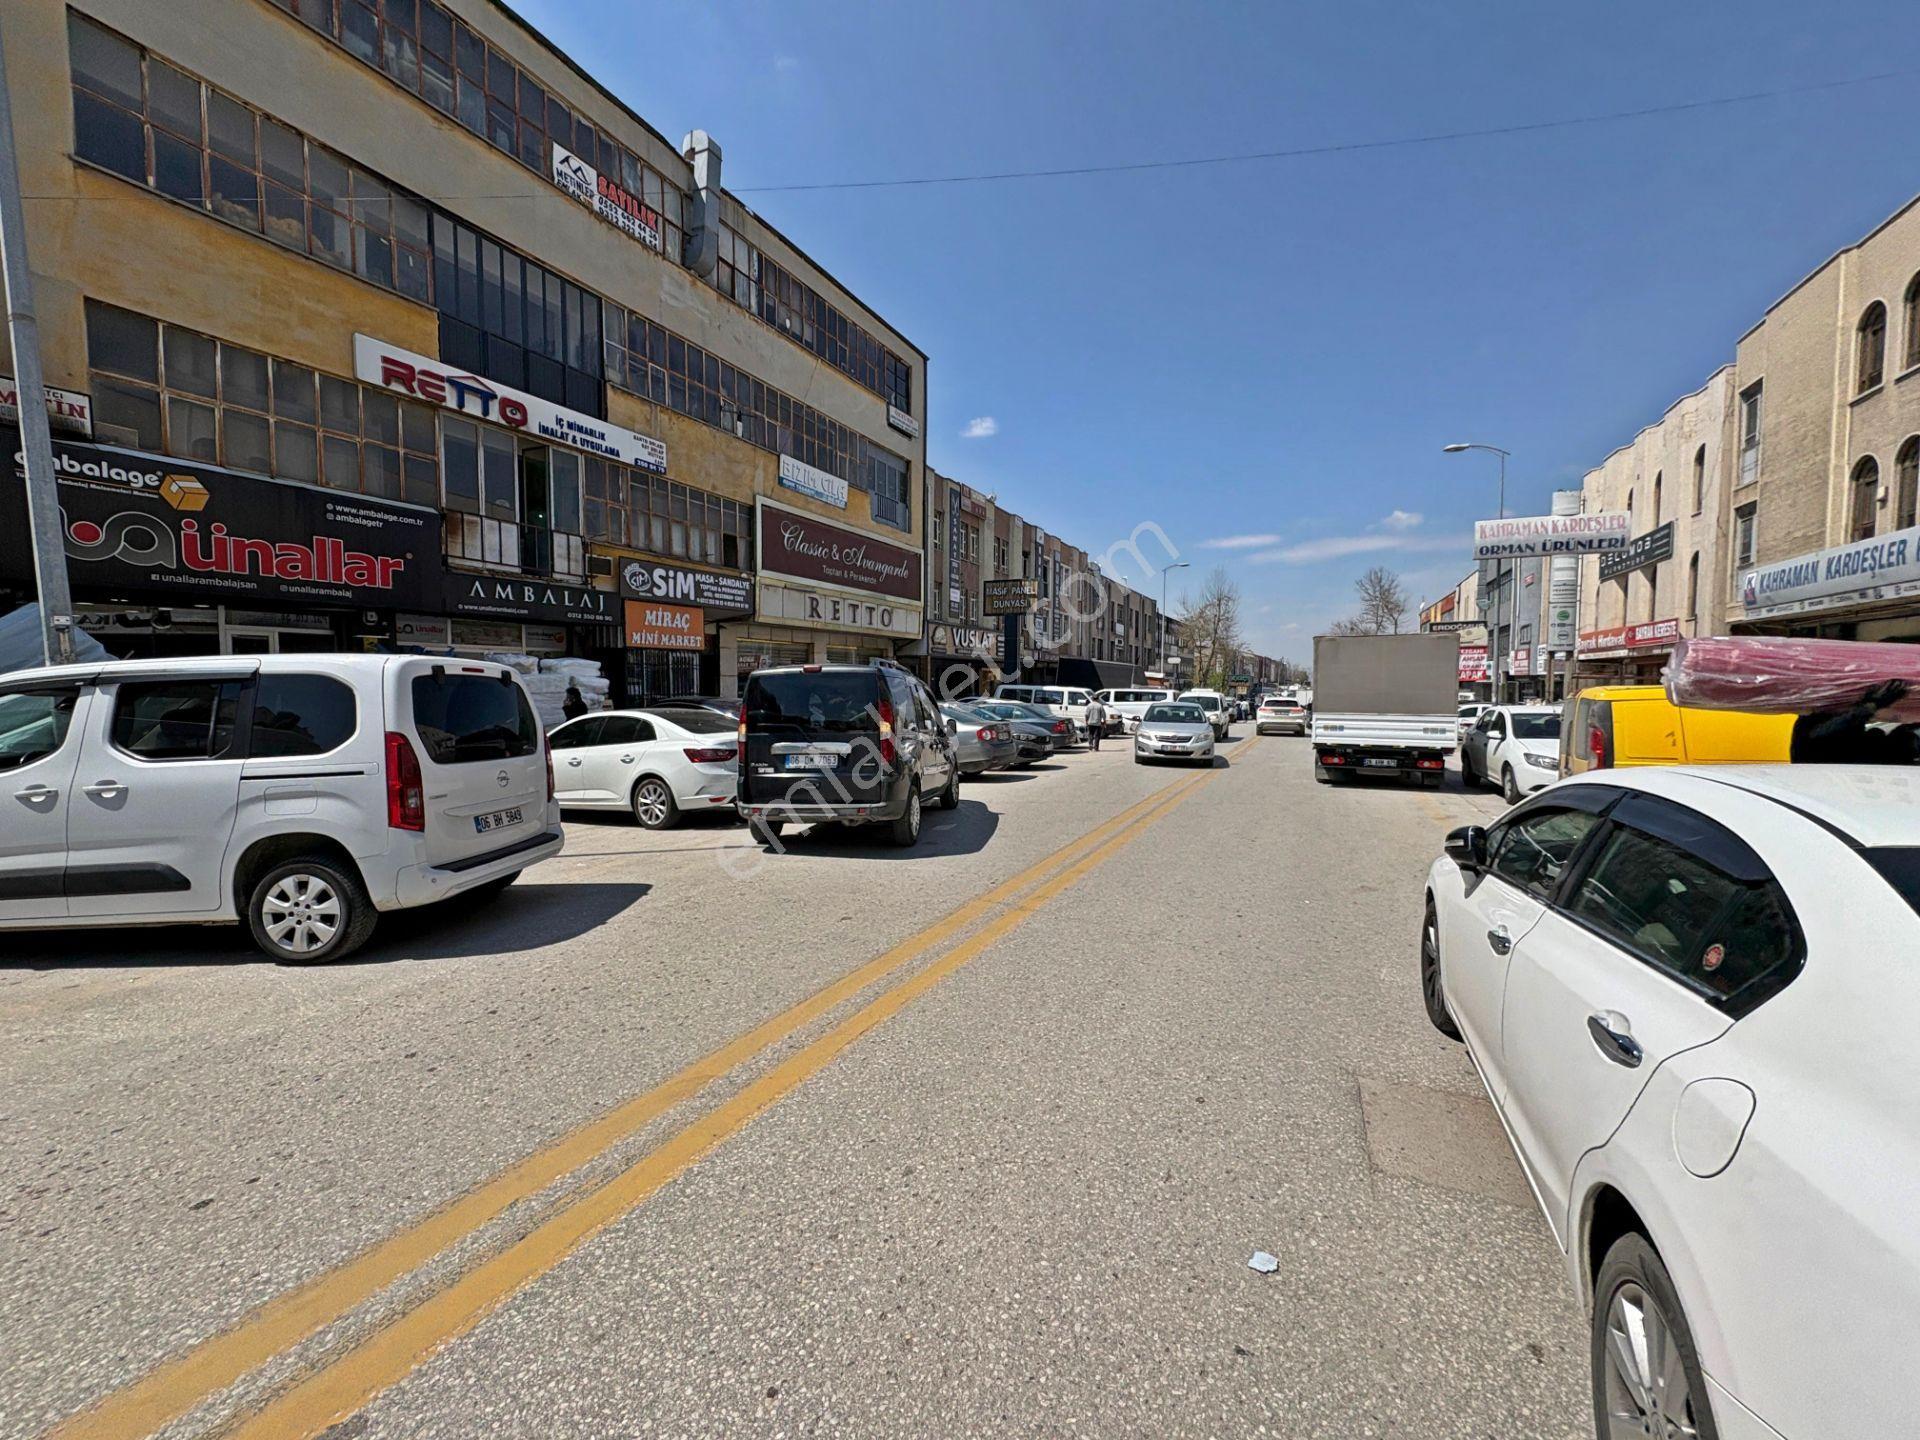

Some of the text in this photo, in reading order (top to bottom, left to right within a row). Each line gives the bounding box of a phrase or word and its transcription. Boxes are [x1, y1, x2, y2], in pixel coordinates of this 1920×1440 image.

[598, 176, 657, 231] SATILIK
[380, 355, 529, 428] RETTO
[0, 390, 87, 420] MİN
[538, 420, 621, 459] İMALAT & UYGULAMA
[555, 413, 607, 442] İÇ MİMARLIK
[335, 503, 424, 527] www.ambalage.com.tr
[335, 513, 384, 528] ambalagetr
[1478, 514, 1627, 540] KAHRAMAN KARDEŞLER
[180, 518, 405, 590] ünallar
[780, 520, 830, 561] Classic
[831, 543, 840, 561] &
[842, 544, 910, 582] Avangarde
[1478, 534, 1626, 557] ORMAN ÜRÜNLERİ
[822, 564, 843, 578] Toptan
[849, 571, 878, 585] Perakende
[1759, 559, 1820, 595] KAHRAMAN
[1825, 538, 1908, 580] KARDEŞLER
[161, 573, 258, 590] unallarambalajsan
[288, 584, 352, 598] unallarambalaj
[695, 573, 715, 585] MASA
[718, 576, 750, 590] SANDALYE
[1011, 585, 1036, 595] PANEL
[469, 580, 605, 613] AMBALAJ
[644, 607, 690, 632] MİRAÇ
[808, 596, 892, 628] RETTO
[632, 629, 702, 648] MİNİ MARKET
[951, 627, 995, 649] VUSLAT
[480, 809, 522, 830] 06 BH 5849
